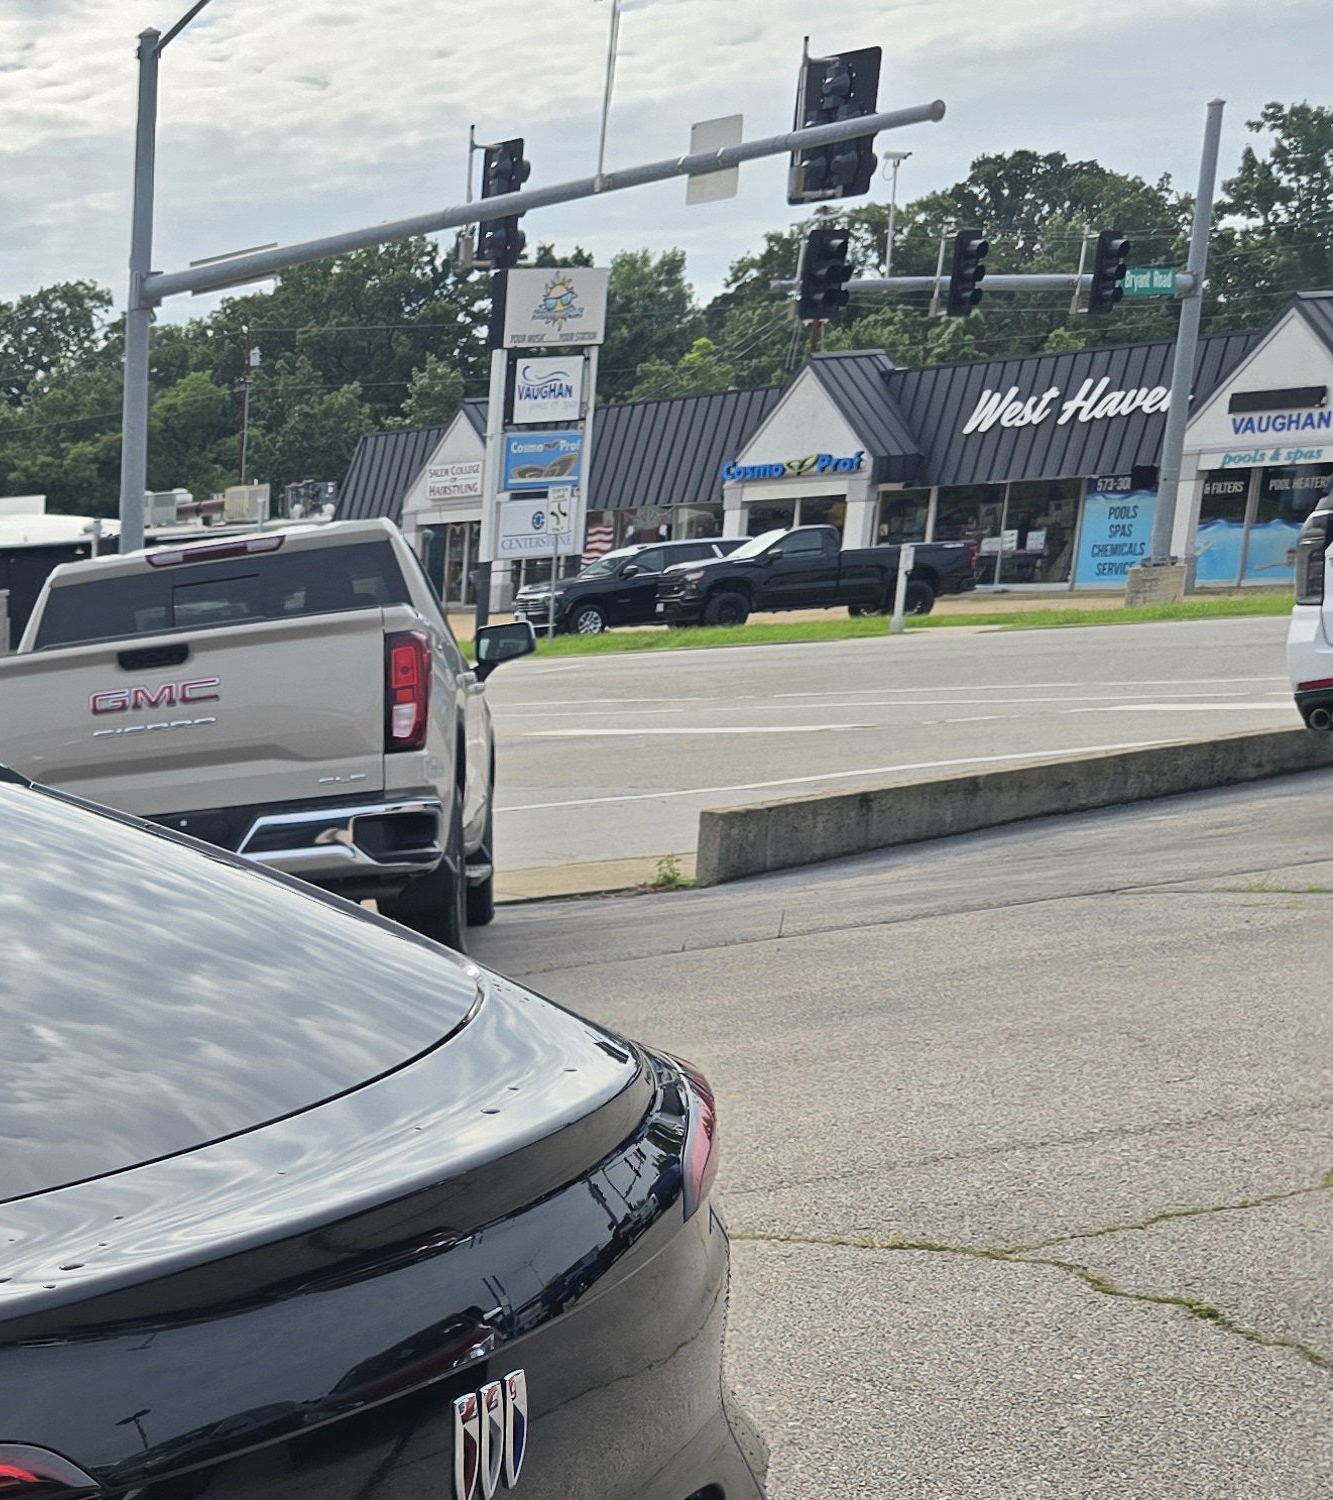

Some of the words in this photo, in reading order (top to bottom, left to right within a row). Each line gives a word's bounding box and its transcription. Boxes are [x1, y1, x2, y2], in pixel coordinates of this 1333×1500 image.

[1124, 270, 1150, 292] Bryant
[1153, 270, 1172, 288] Road
[517, 383, 572, 400] VAUGHAN
[963, 386, 1060, 434] West
[1232, 411, 1331, 435] VAUGHAN
[511, 441, 544, 453] Cosmo
[559, 440, 581, 451] Prof
[721, 461, 786, 480] Cosmo
[817, 451, 864, 473] Prof
[1220, 449, 1266, 469] pools
[1269, 448, 1281, 461] &
[1285, 449, 1323, 465] spas
[1211, 481, 1244, 494] FILTERS
[1269, 479, 1290, 490] POOL
[1108, 505, 1139, 520] POOLS
[1108, 523, 1133, 538] SPAS
[1091, 542, 1145, 558] CHEMICALS
[1096, 561, 1135, 576] SERVIC
[90, 677, 220, 715] GMC
